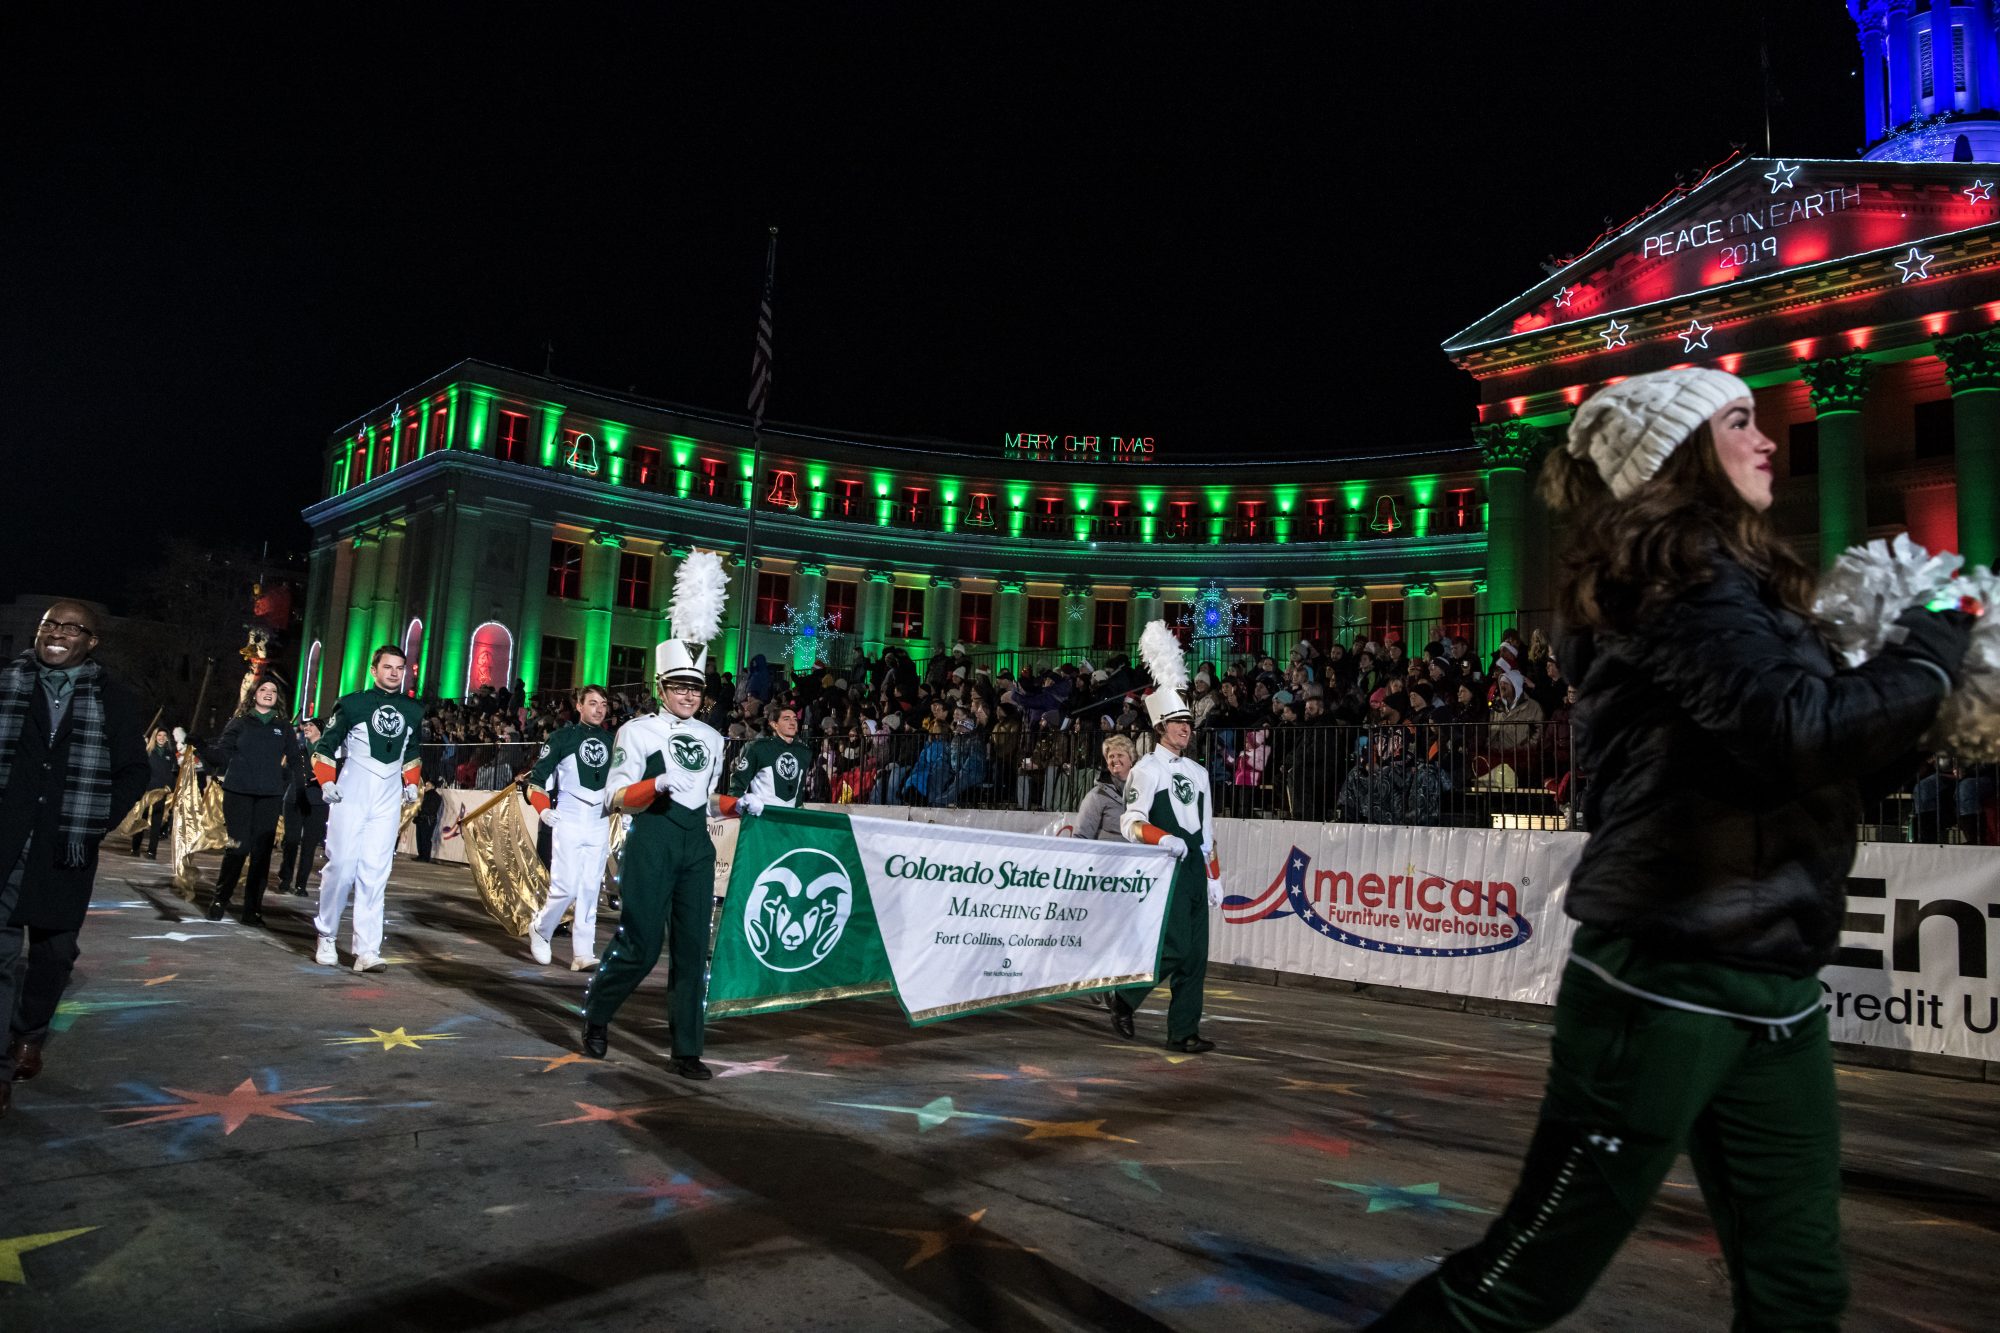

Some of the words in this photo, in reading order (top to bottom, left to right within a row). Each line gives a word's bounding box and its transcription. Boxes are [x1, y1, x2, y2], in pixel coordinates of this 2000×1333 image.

[1643, 219, 1725, 260] PEACE
[1729, 208, 1765, 235] ON
[1769, 184, 1861, 229] EARTH
[1718, 236, 1778, 269] 2019
[1004, 432, 1059, 450] MERRY
[884, 853, 994, 886] Colorado
[993, 860, 1050, 891] State
[1052, 866, 1159, 904] University
[946, 896, 1041, 922] MARCHING
[1043, 901, 1089, 923] BAND
[1328, 904, 1401, 929] Furniture
[1406, 911, 1514, 939] Warehouse
[934, 931, 961, 946] Fort
[962, 932, 1007, 948] Collins,
[1008, 933, 1058, 948] Colorado
[1060, 935, 1083, 948] USA
[1837, 876, 2000, 979] En
